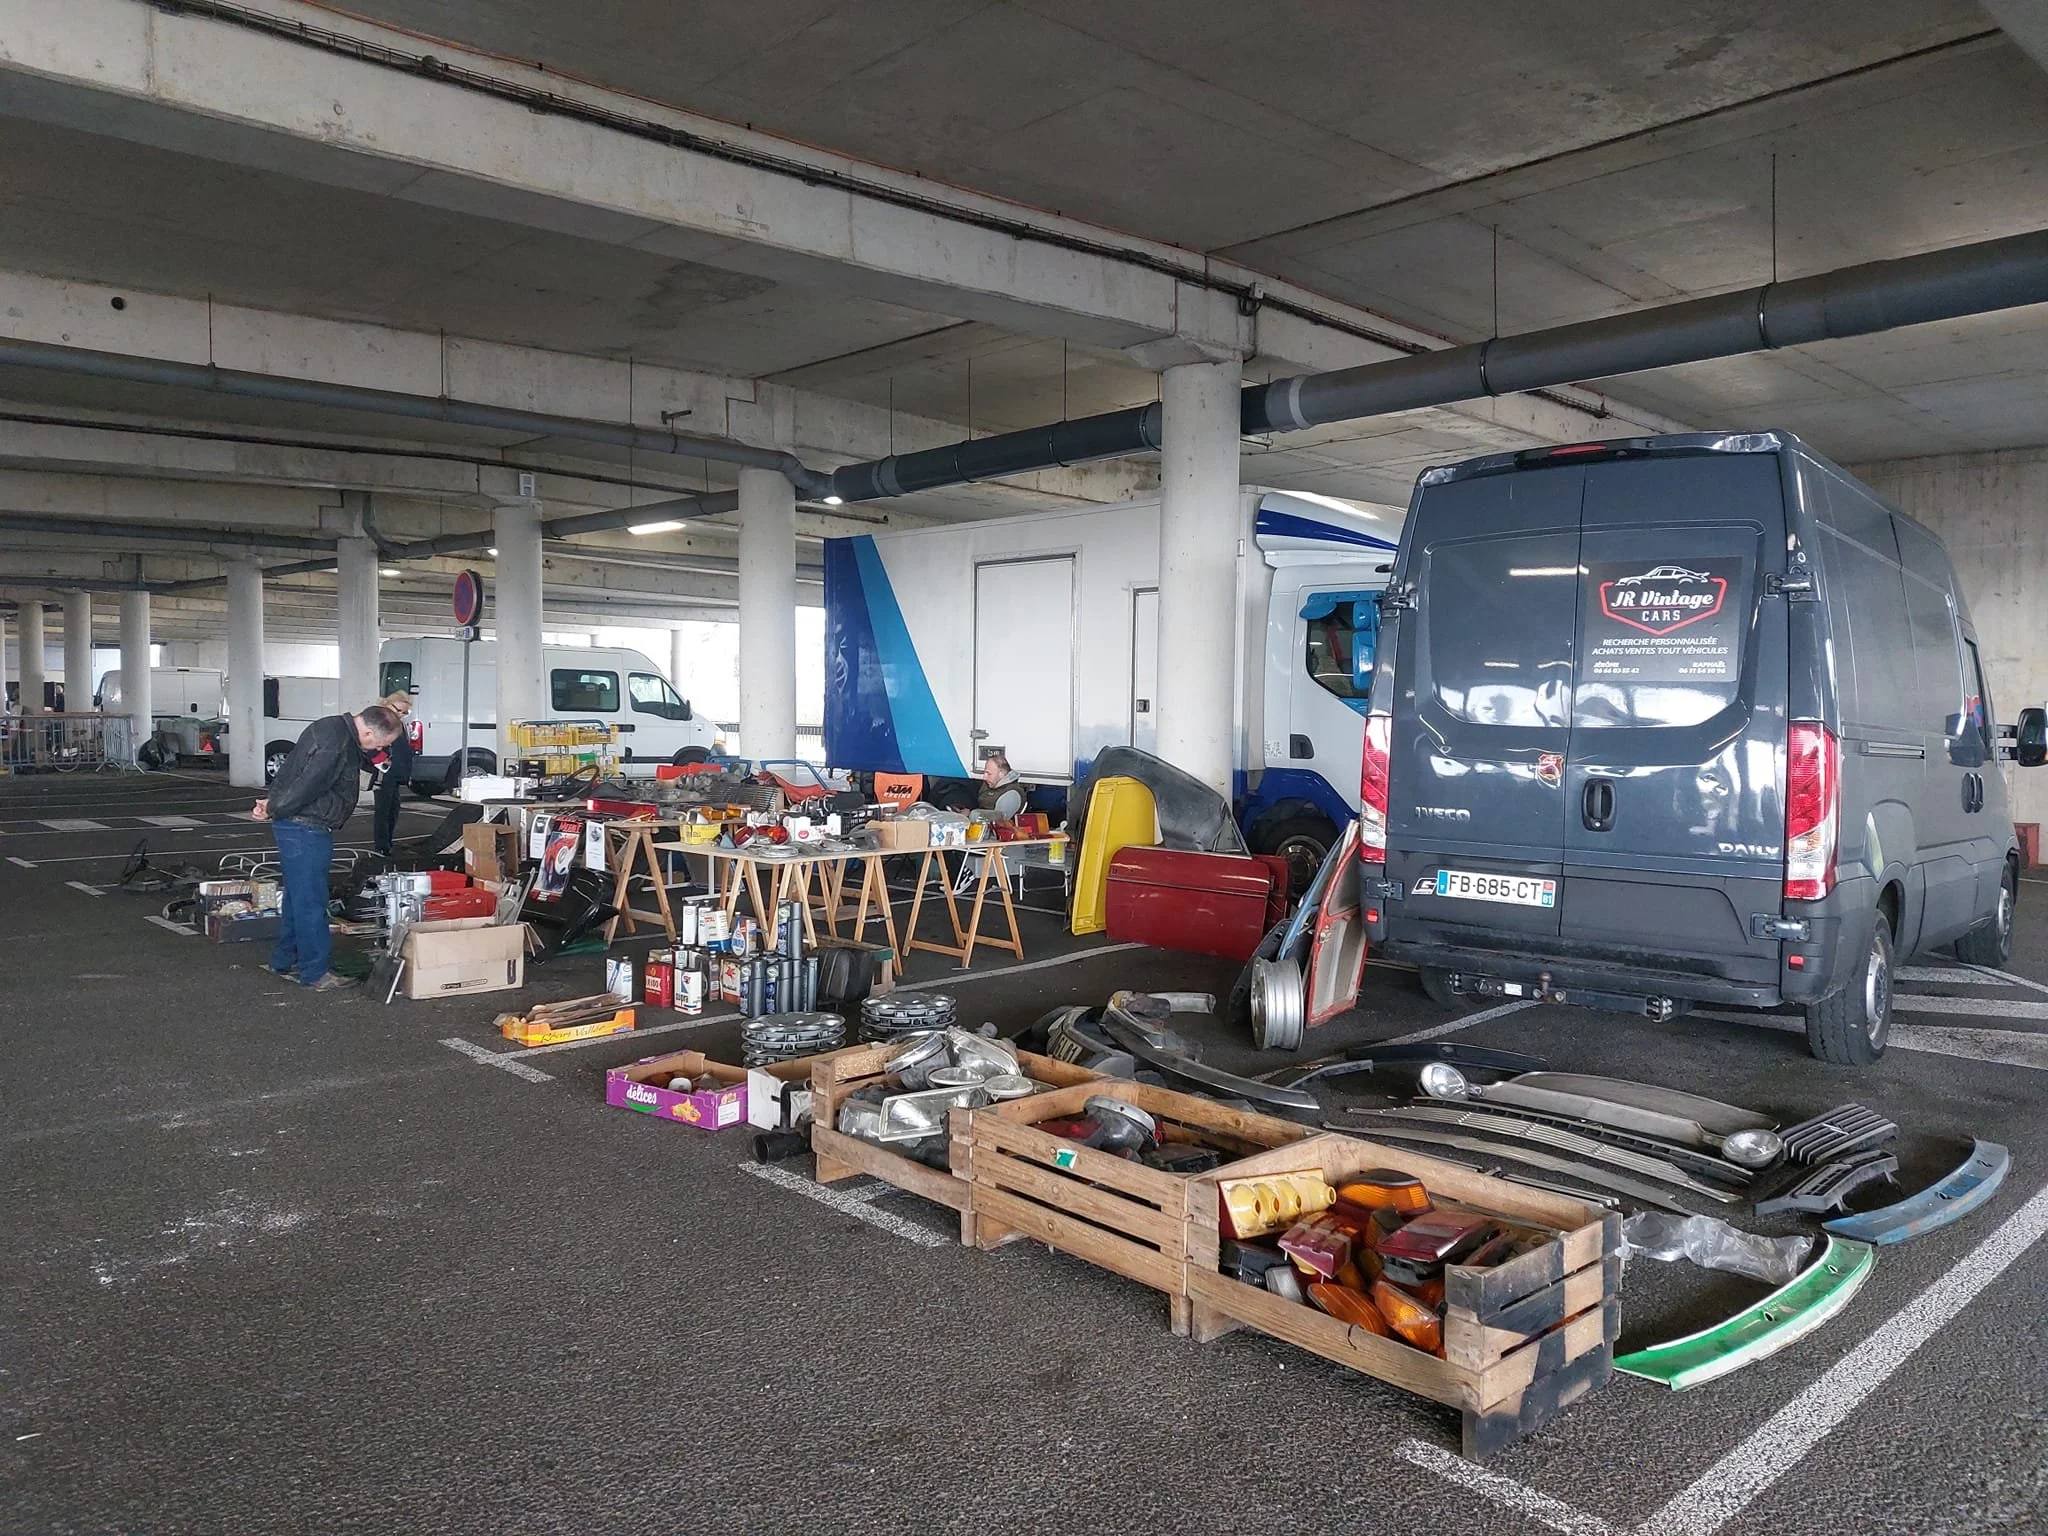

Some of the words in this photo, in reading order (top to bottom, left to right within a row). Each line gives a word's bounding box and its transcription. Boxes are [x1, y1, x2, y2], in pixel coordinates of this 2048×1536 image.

[1610, 590, 1636, 607] JR
[1640, 589, 1714, 609] Vintage
[1642, 610, 1680, 621] CARS
[1602, 638, 1650, 646] RECHERCHE
[1650, 636, 1718, 645] PERSONNALISÉE
[1592, 647, 1624, 655] ACHATS
[1682, 645, 1728, 654] VÉHICULES
[886, 784, 913, 793] KTM
[1415, 806, 1471, 823] IVECO
[1718, 843, 1779, 856] DAILY
[1449, 874, 1541, 900] FB-685-CT
[626, 1084, 657, 1104] délices
